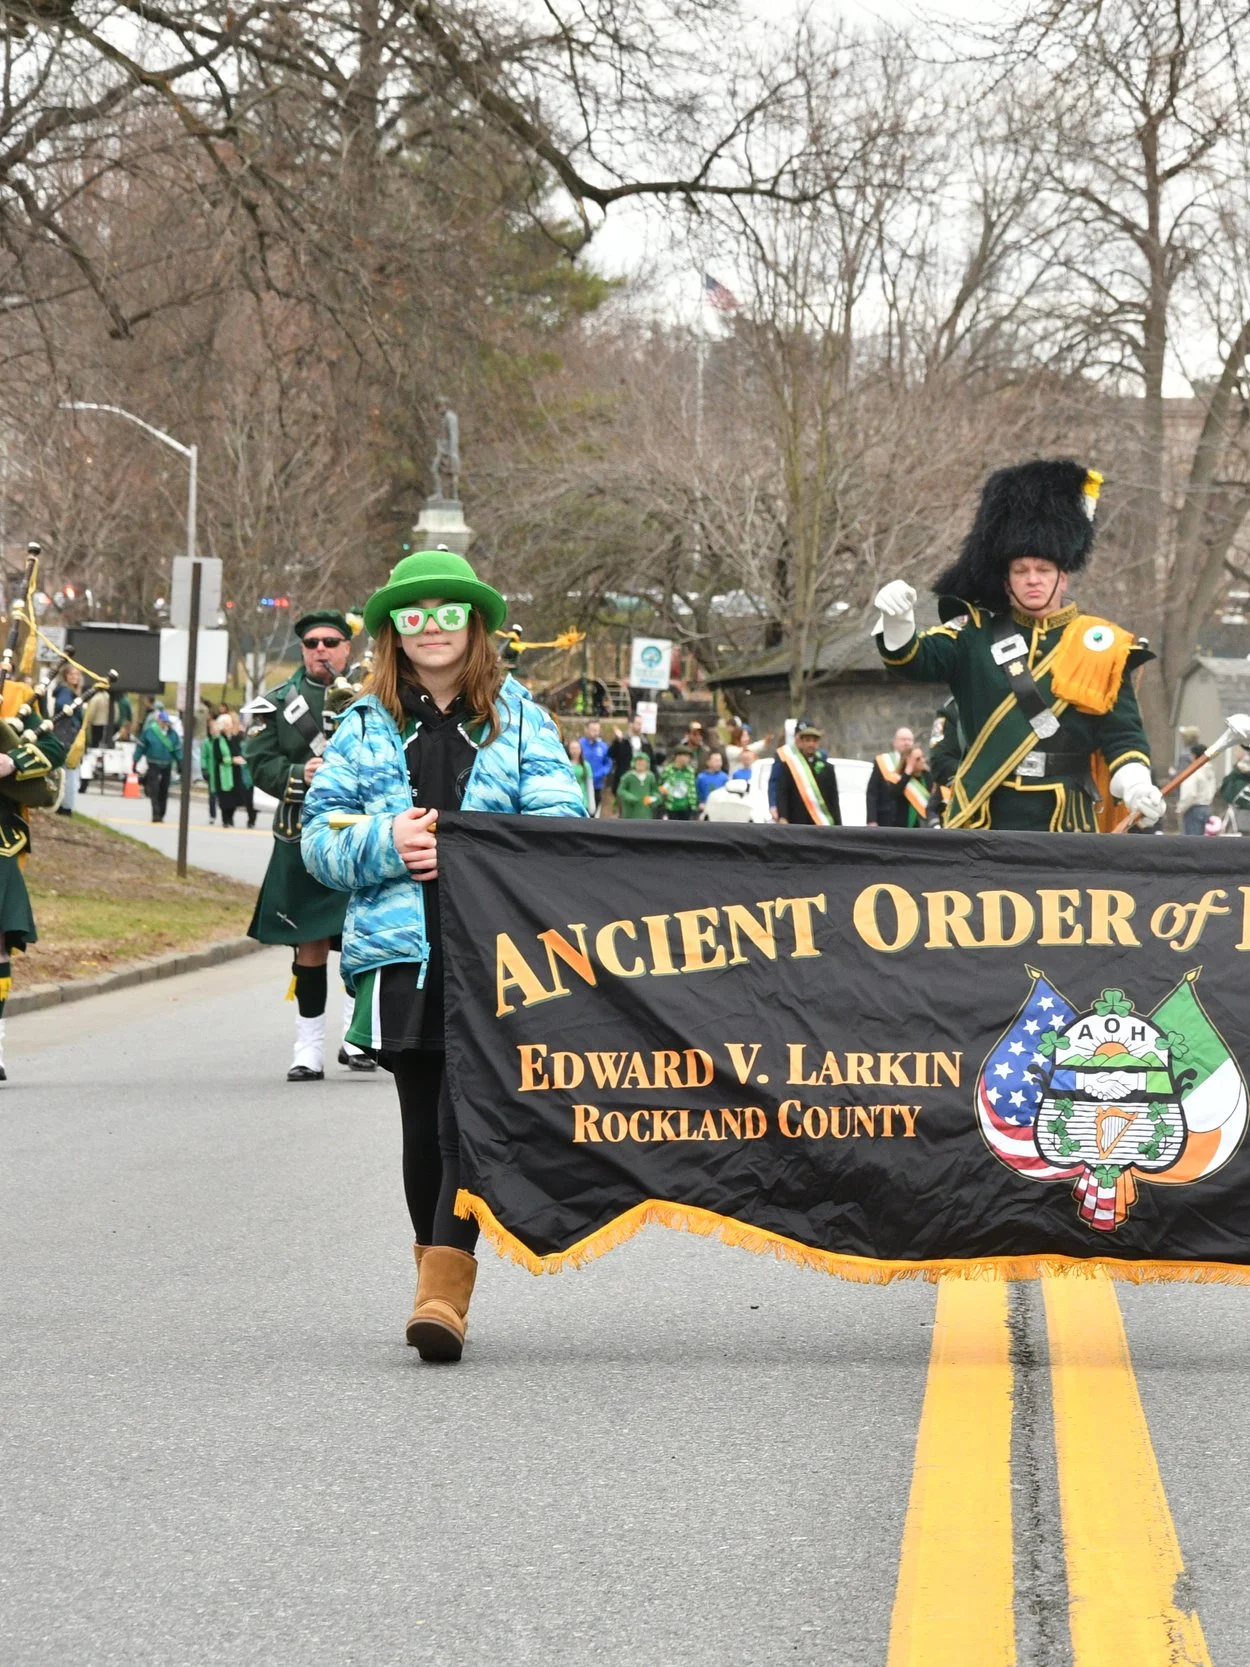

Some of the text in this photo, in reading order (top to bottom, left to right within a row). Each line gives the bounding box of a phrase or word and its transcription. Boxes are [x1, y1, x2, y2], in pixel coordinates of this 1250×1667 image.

[400, 615, 408, 628] I
[495, 892, 828, 1018] ANCIENT
[852, 882, 1143, 953] ORDER
[1150, 888, 1232, 952] of
[516, 1042, 964, 1092] EDWARD V. LARKIN
[571, 1098, 923, 1143] ROCKLAND COUNTY
